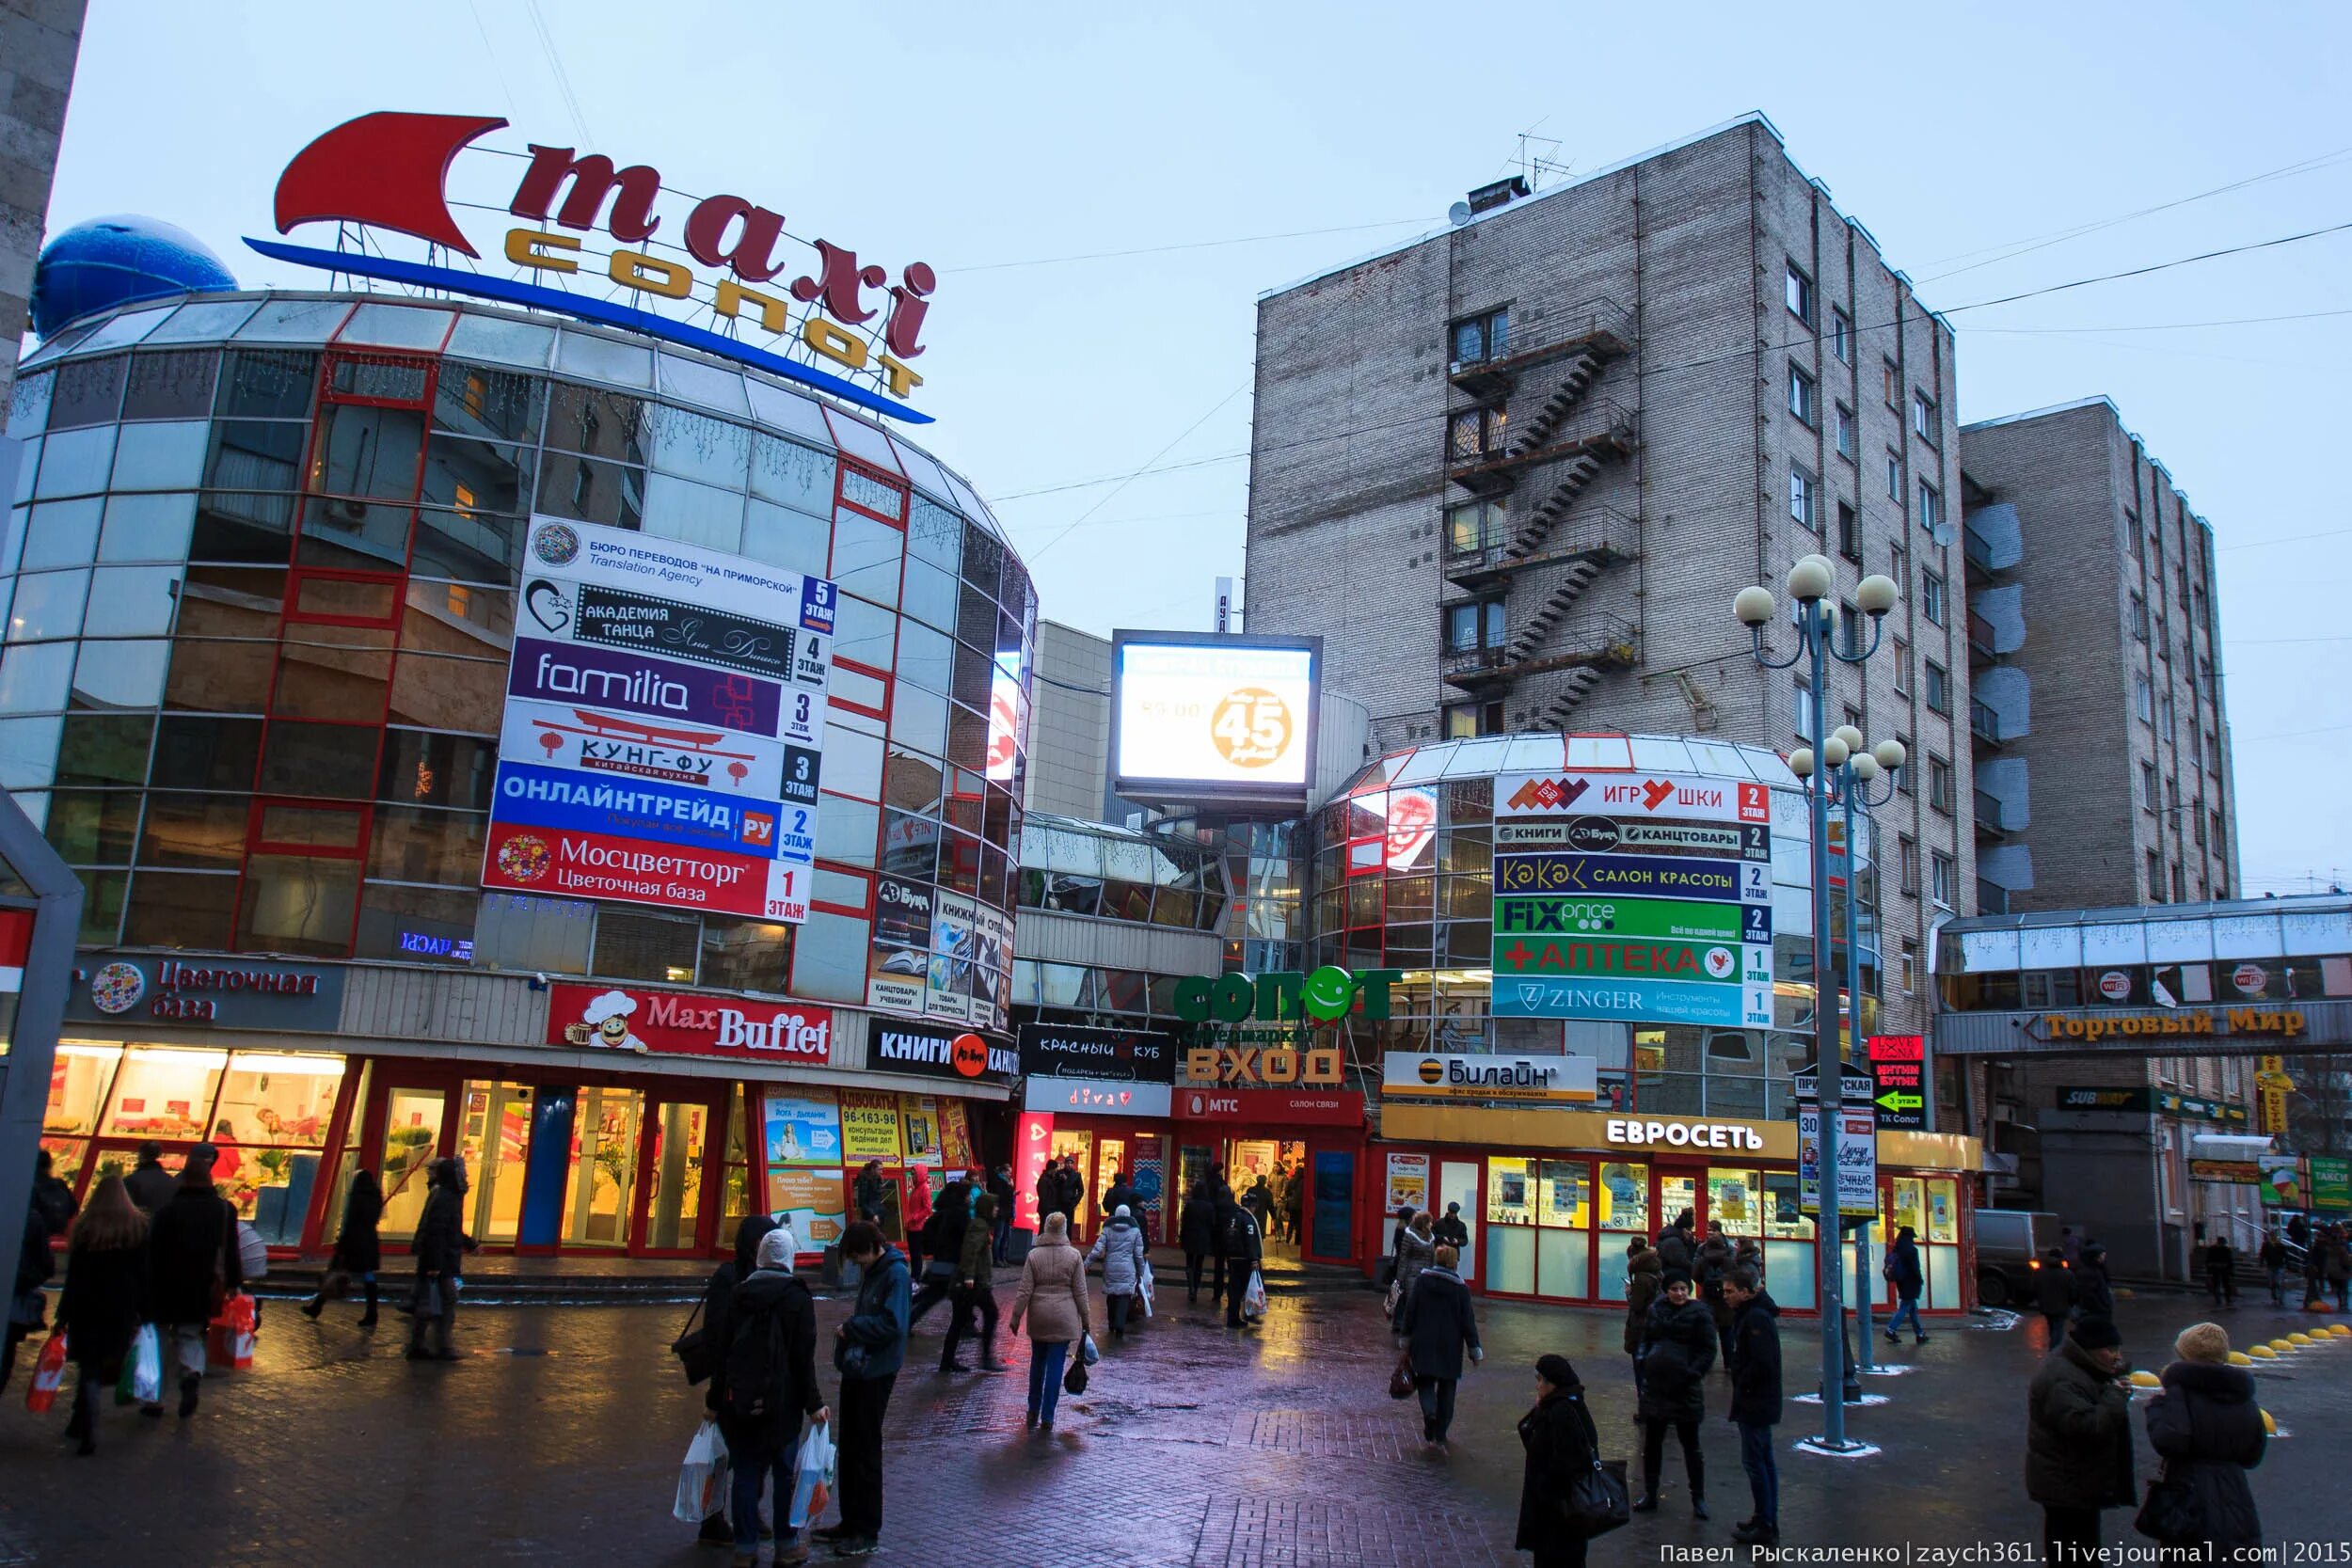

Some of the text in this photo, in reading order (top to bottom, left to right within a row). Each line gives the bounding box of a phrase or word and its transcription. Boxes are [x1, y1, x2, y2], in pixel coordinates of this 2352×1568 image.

[509, 143, 937, 359] maxi
[589, 541, 627, 557] БЮРО
[628, 546, 699, 572] ПЕРЕВОДОВ
[589, 553, 704, 589] Translation Agency
[814, 579, 830, 606] 5
[585, 605, 669, 623] АКАДЕМИЯ
[805, 602, 834, 621] ЭТАЖ
[601, 623, 655, 641] ТАНЦА
[806, 636, 820, 659] 4
[797, 658, 825, 676] ЭТАЖ
[535, 651, 690, 713] familia
[796, 694, 811, 723] 3
[1215, 703, 1285, 749] 45
[580, 737, 714, 774] КУНГ-ФУ
[594, 758, 697, 783] китайская кухня
[795, 755, 810, 781] 3
[785, 780, 815, 800] ЭТАЖ
[1748, 787, 1759, 806] 2
[502, 775, 731, 832] ОНЛАЙНТРЕЙД
[1742, 806, 1766, 819] ЭТАЖ
[793, 809, 808, 833] 2
[783, 832, 813, 850] ЭТАЖ
[1514, 827, 1563, 840] КНИГИ
[1642, 829, 1739, 846] КАНЦТОВАРЫ
[1751, 827, 1761, 847] 2
[559, 837, 746, 886] Мосцветторг
[1744, 847, 1768, 860] ЭТАЖ
[557, 867, 707, 903] Цветочная база
[782, 870, 794, 897] 1
[1593, 868, 1653, 884] САЛОН
[1660, 871, 1733, 889] КРАСОТЫ
[1751, 867, 1761, 886] 2
[1745, 887, 1768, 900] ЭТАЖ
[768, 898, 805, 920] ЭТАЖ
[942, 902, 986, 927] КНИЖНЫЙ
[1752, 909, 1763, 928] 2
[1745, 929, 1770, 942] ЭТАЖ
[1537, 942, 1702, 974] АПТЕКА
[1753, 949, 1763, 970] 1
[156, 959, 322, 995] Цветочная
[1746, 970, 1770, 983] ЭТАЖ
[875, 983, 918, 997] КАНЦТОВАРЫ
[1549, 988, 1644, 1010] ZINGER
[1655, 991, 1722, 1005] Инструменты
[150, 991, 217, 1022] база
[880, 994, 913, 1006] УЧЕБНИКИ
[1754, 991, 1763, 1011] 1
[1691, 1006, 1732, 1018] красоты
[1746, 1011, 1770, 1024] ЭТАЖ
[646, 995, 830, 1055] Max Buffet
[2043, 1006, 2305, 1042] Торговый Мир
[880, 1032, 951, 1065] КНИГИ
[1133, 1045, 1160, 1059] КУБ
[1187, 1048, 1345, 1084] ВХОД
[1449, 1059, 1549, 1086] Билайн
[1798, 1078, 1870, 1092] ПРИСКАЯ
[1879, 1075, 1919, 1086] БУТИК
[1069, 1087, 1116, 1106] diva
[1449, 1088, 1466, 1097] офис
[1466, 1089, 1491, 1098] продаж
[1498, 1089, 1548, 1098] обслуживания
[2066, 1090, 2135, 1105] SUBWAY
[796, 1110, 827, 1119] ДЫХАНИЕ
[1209, 1098, 1239, 1114] МТС
[1289, 1099, 1340, 1111] салон связи
[843, 1110, 897, 1126] 96-163-96
[1802, 1117, 1818, 1132] 30
[1881, 1114, 1920, 1124] ТК Сопот
[848, 1126, 894, 1136] консультация
[850, 1135, 893, 1145] ведение дел
[1606, 1118, 1764, 1149] ЕВРОСЕТЬ
[1247, 1224, 1254, 1235] 3
